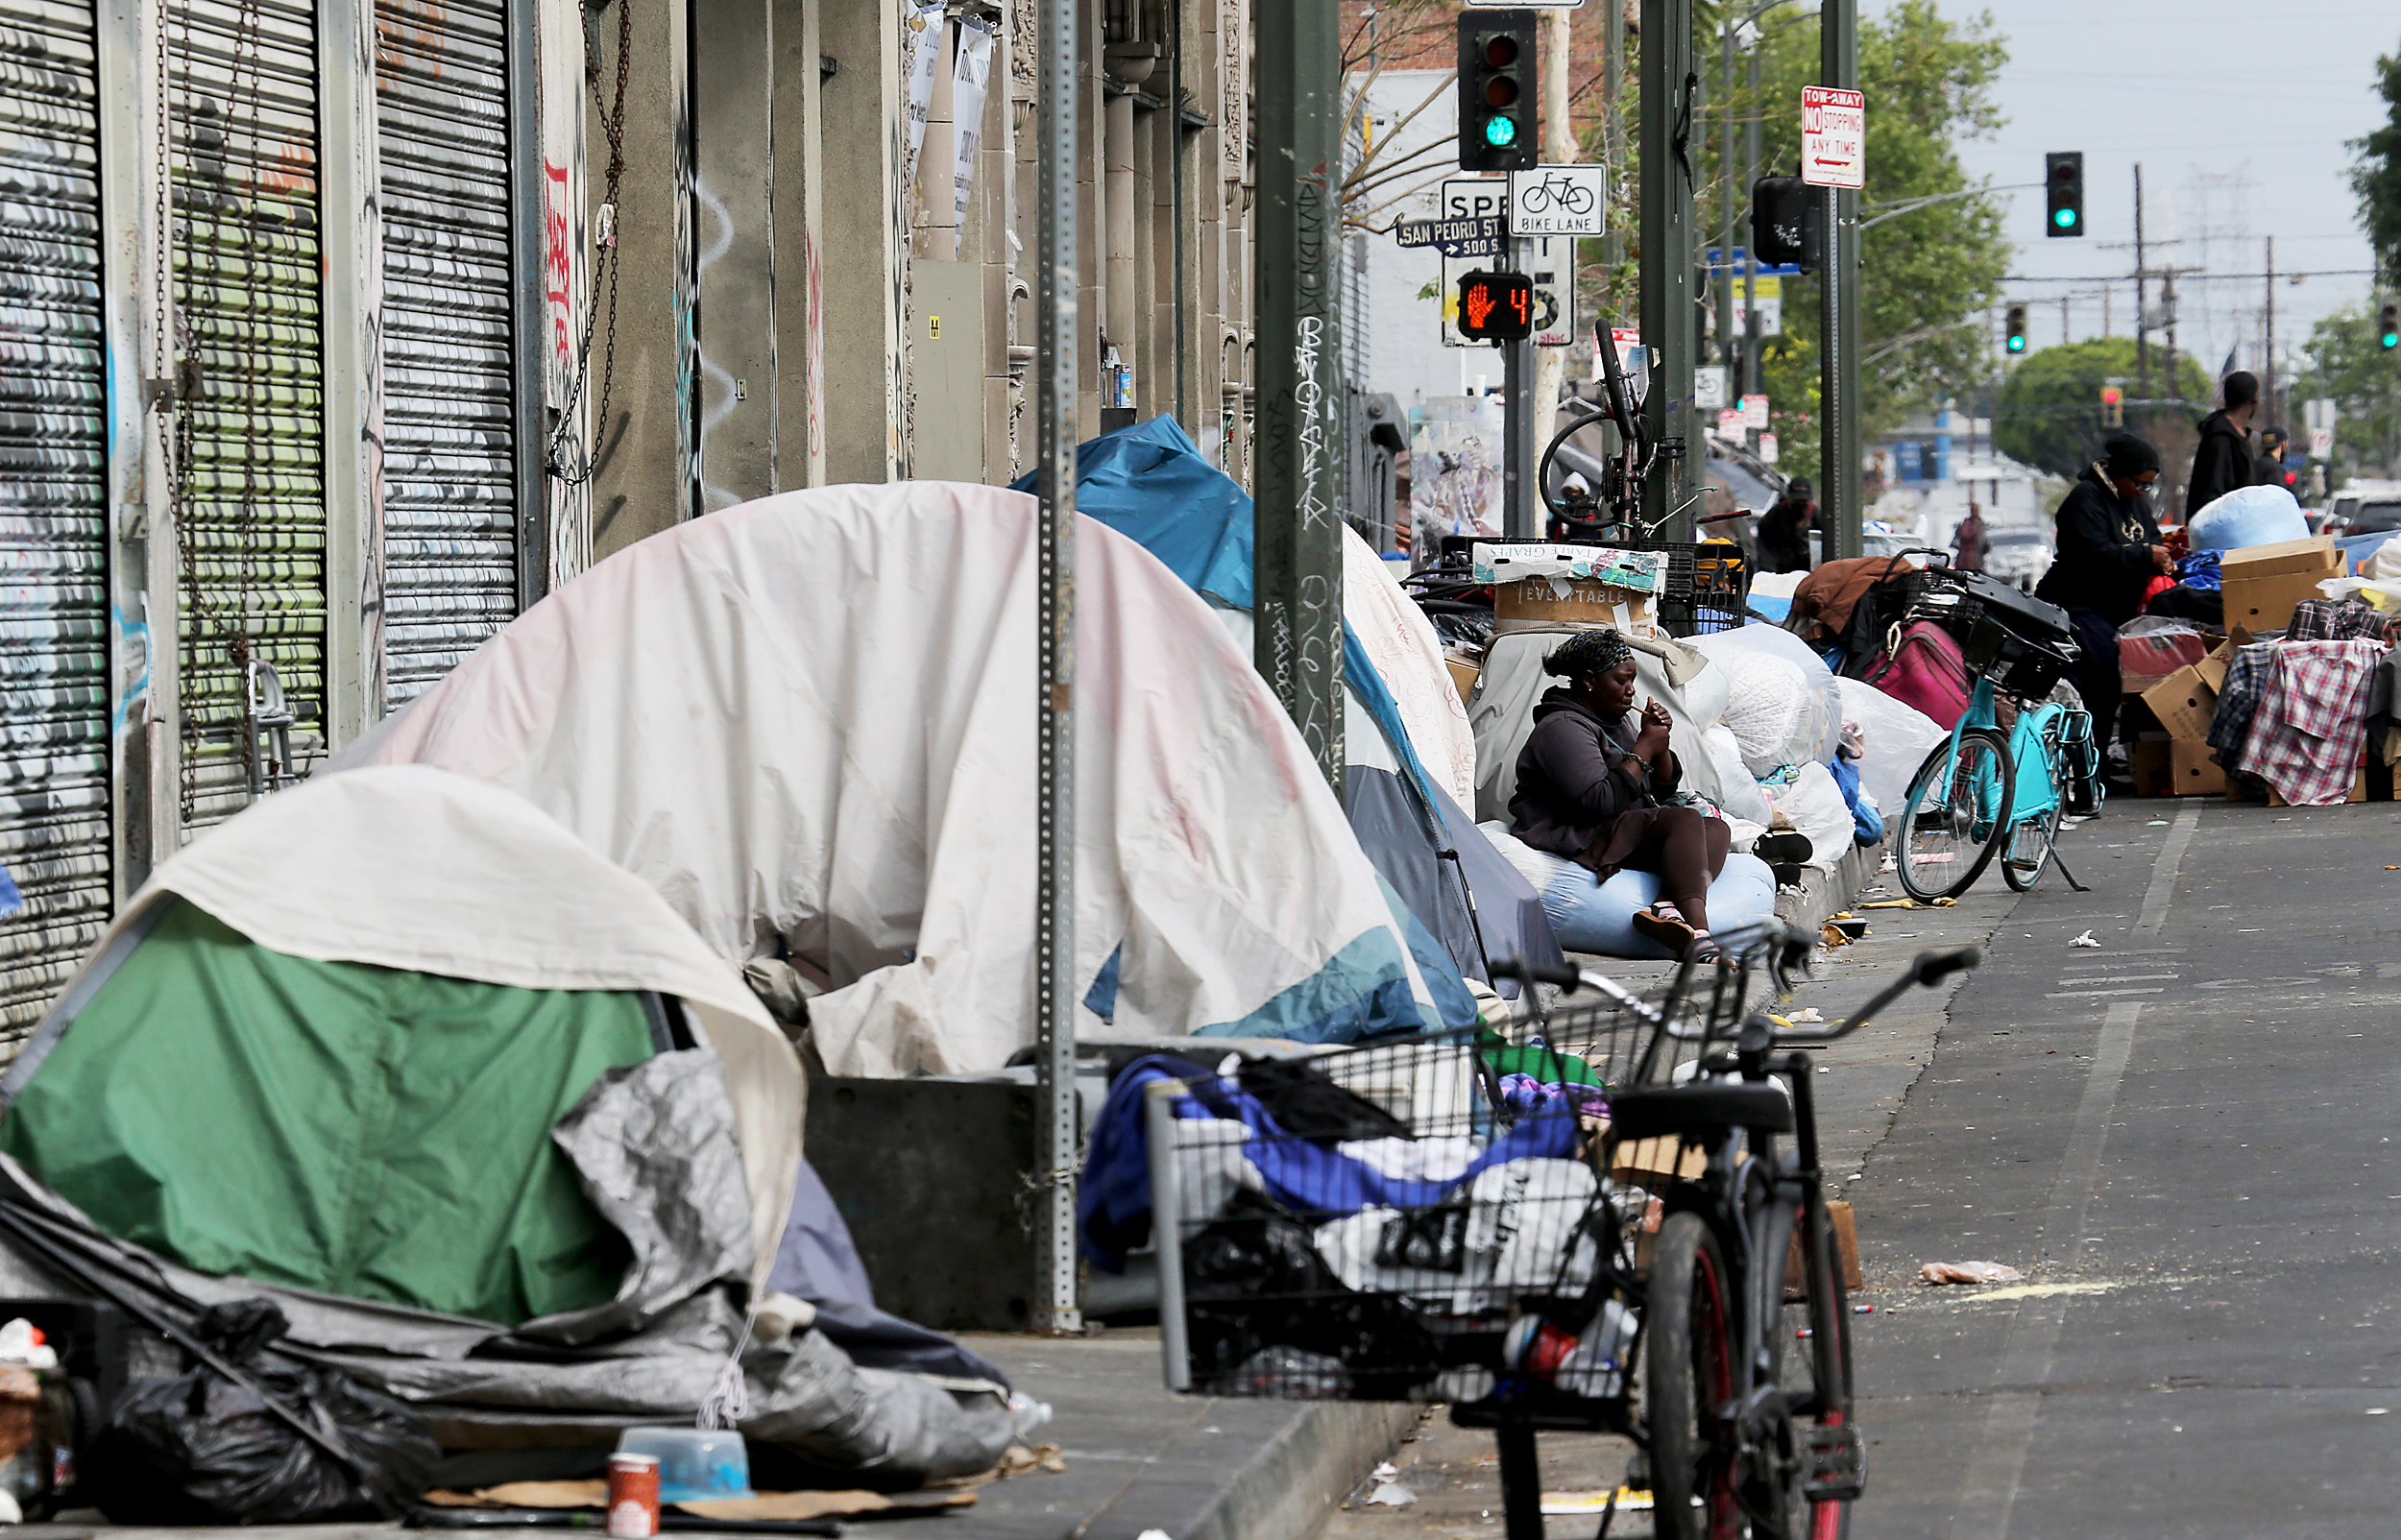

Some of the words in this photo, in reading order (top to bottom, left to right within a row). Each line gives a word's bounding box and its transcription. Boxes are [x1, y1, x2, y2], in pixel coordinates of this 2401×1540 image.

[1806, 89, 1861, 107] TOW-AWAY
[1806, 106, 1822, 132] NO
[1825, 111, 1861, 132] STOPPING
[1811, 137, 1831, 153] ANY
[1835, 139, 1856, 156] TIME
[1402, 226, 1431, 245] SAN
[1434, 220, 1478, 241] PEDRO
[1521, 217, 1551, 231] BIKE
[1557, 217, 1591, 231] LANE
[1463, 239, 1488, 254] 500
[1510, 289, 1528, 325] 4
[1490, 546, 1545, 558] GRAPES
[1550, 546, 1593, 559] TABLE
